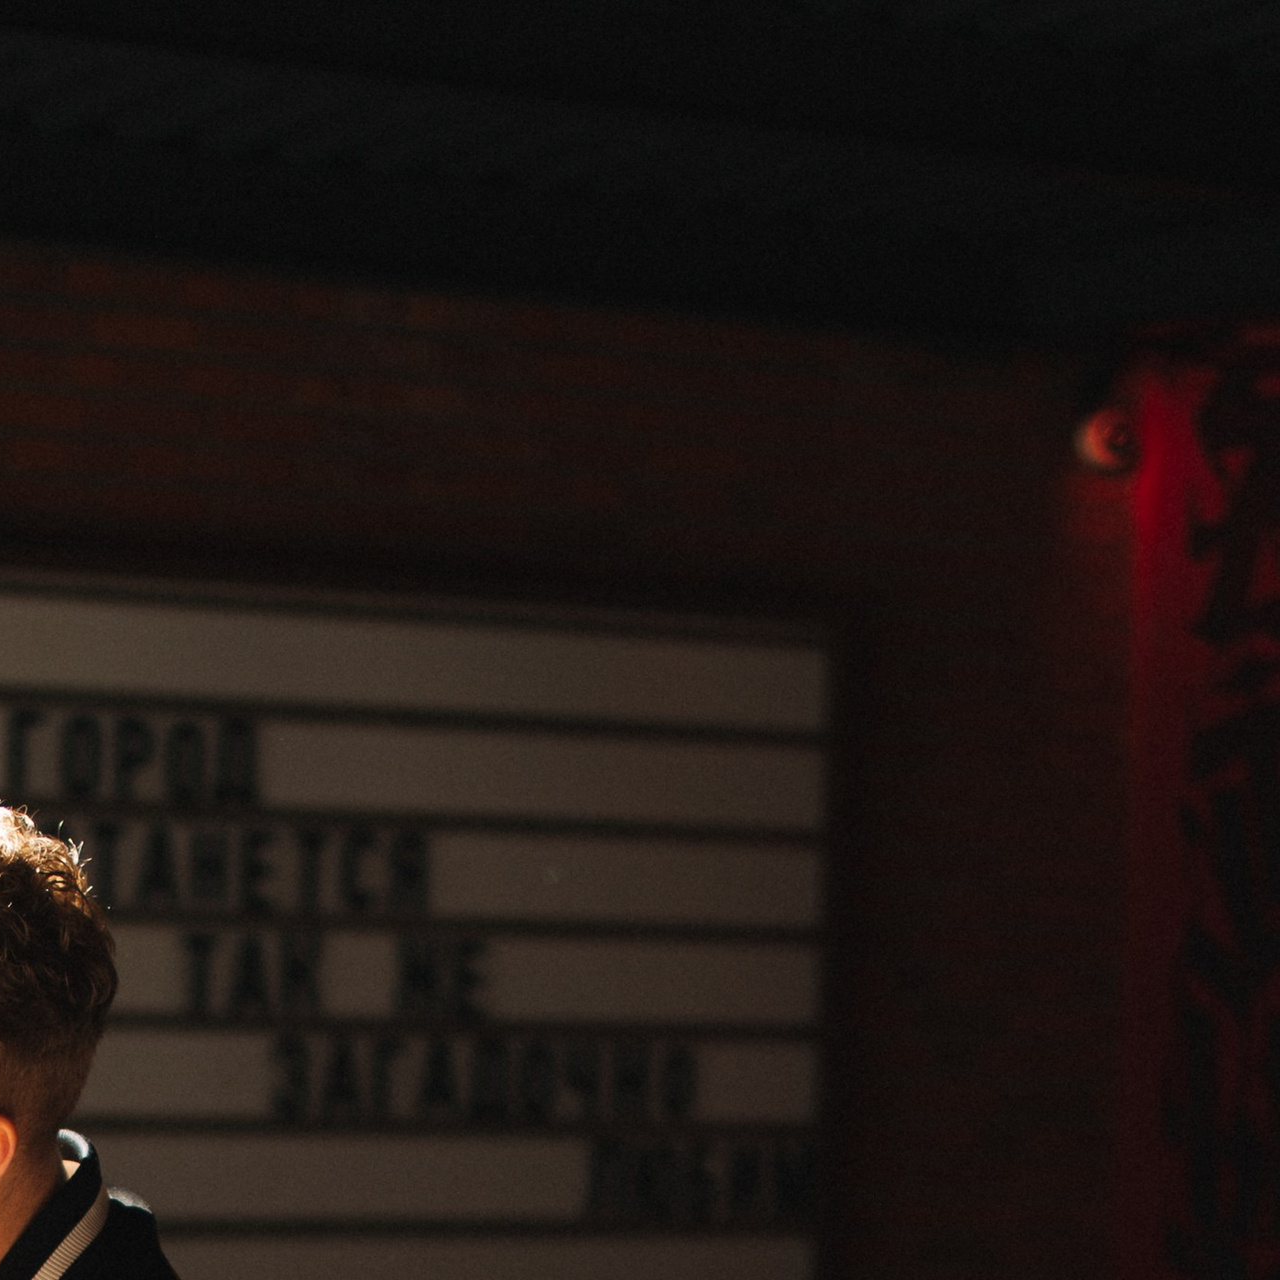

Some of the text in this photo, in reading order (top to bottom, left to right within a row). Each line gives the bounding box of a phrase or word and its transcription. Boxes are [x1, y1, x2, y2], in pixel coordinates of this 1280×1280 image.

[8, 706, 258, 806] ГОРОД
[58, 816, 426, 912] ТАНЕТСЯ
[186, 924, 320, 1016] ТАК
